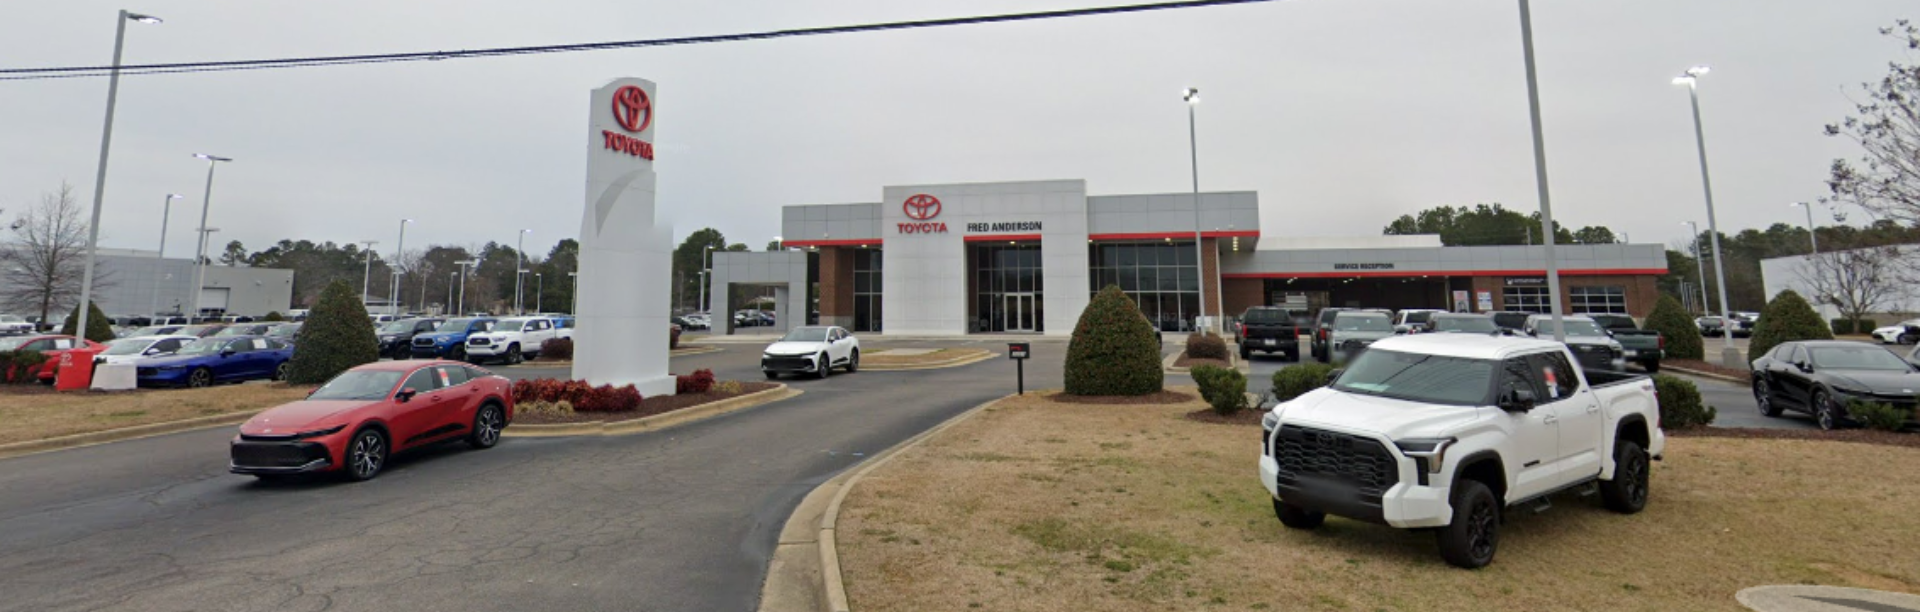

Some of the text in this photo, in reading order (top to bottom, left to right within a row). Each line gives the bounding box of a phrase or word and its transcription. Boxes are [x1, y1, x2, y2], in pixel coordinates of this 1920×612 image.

[602, 130, 654, 161] TOYOTA
[897, 222, 948, 234] TOYOTA
[967, 221, 1042, 232] FRED ANDERSON
